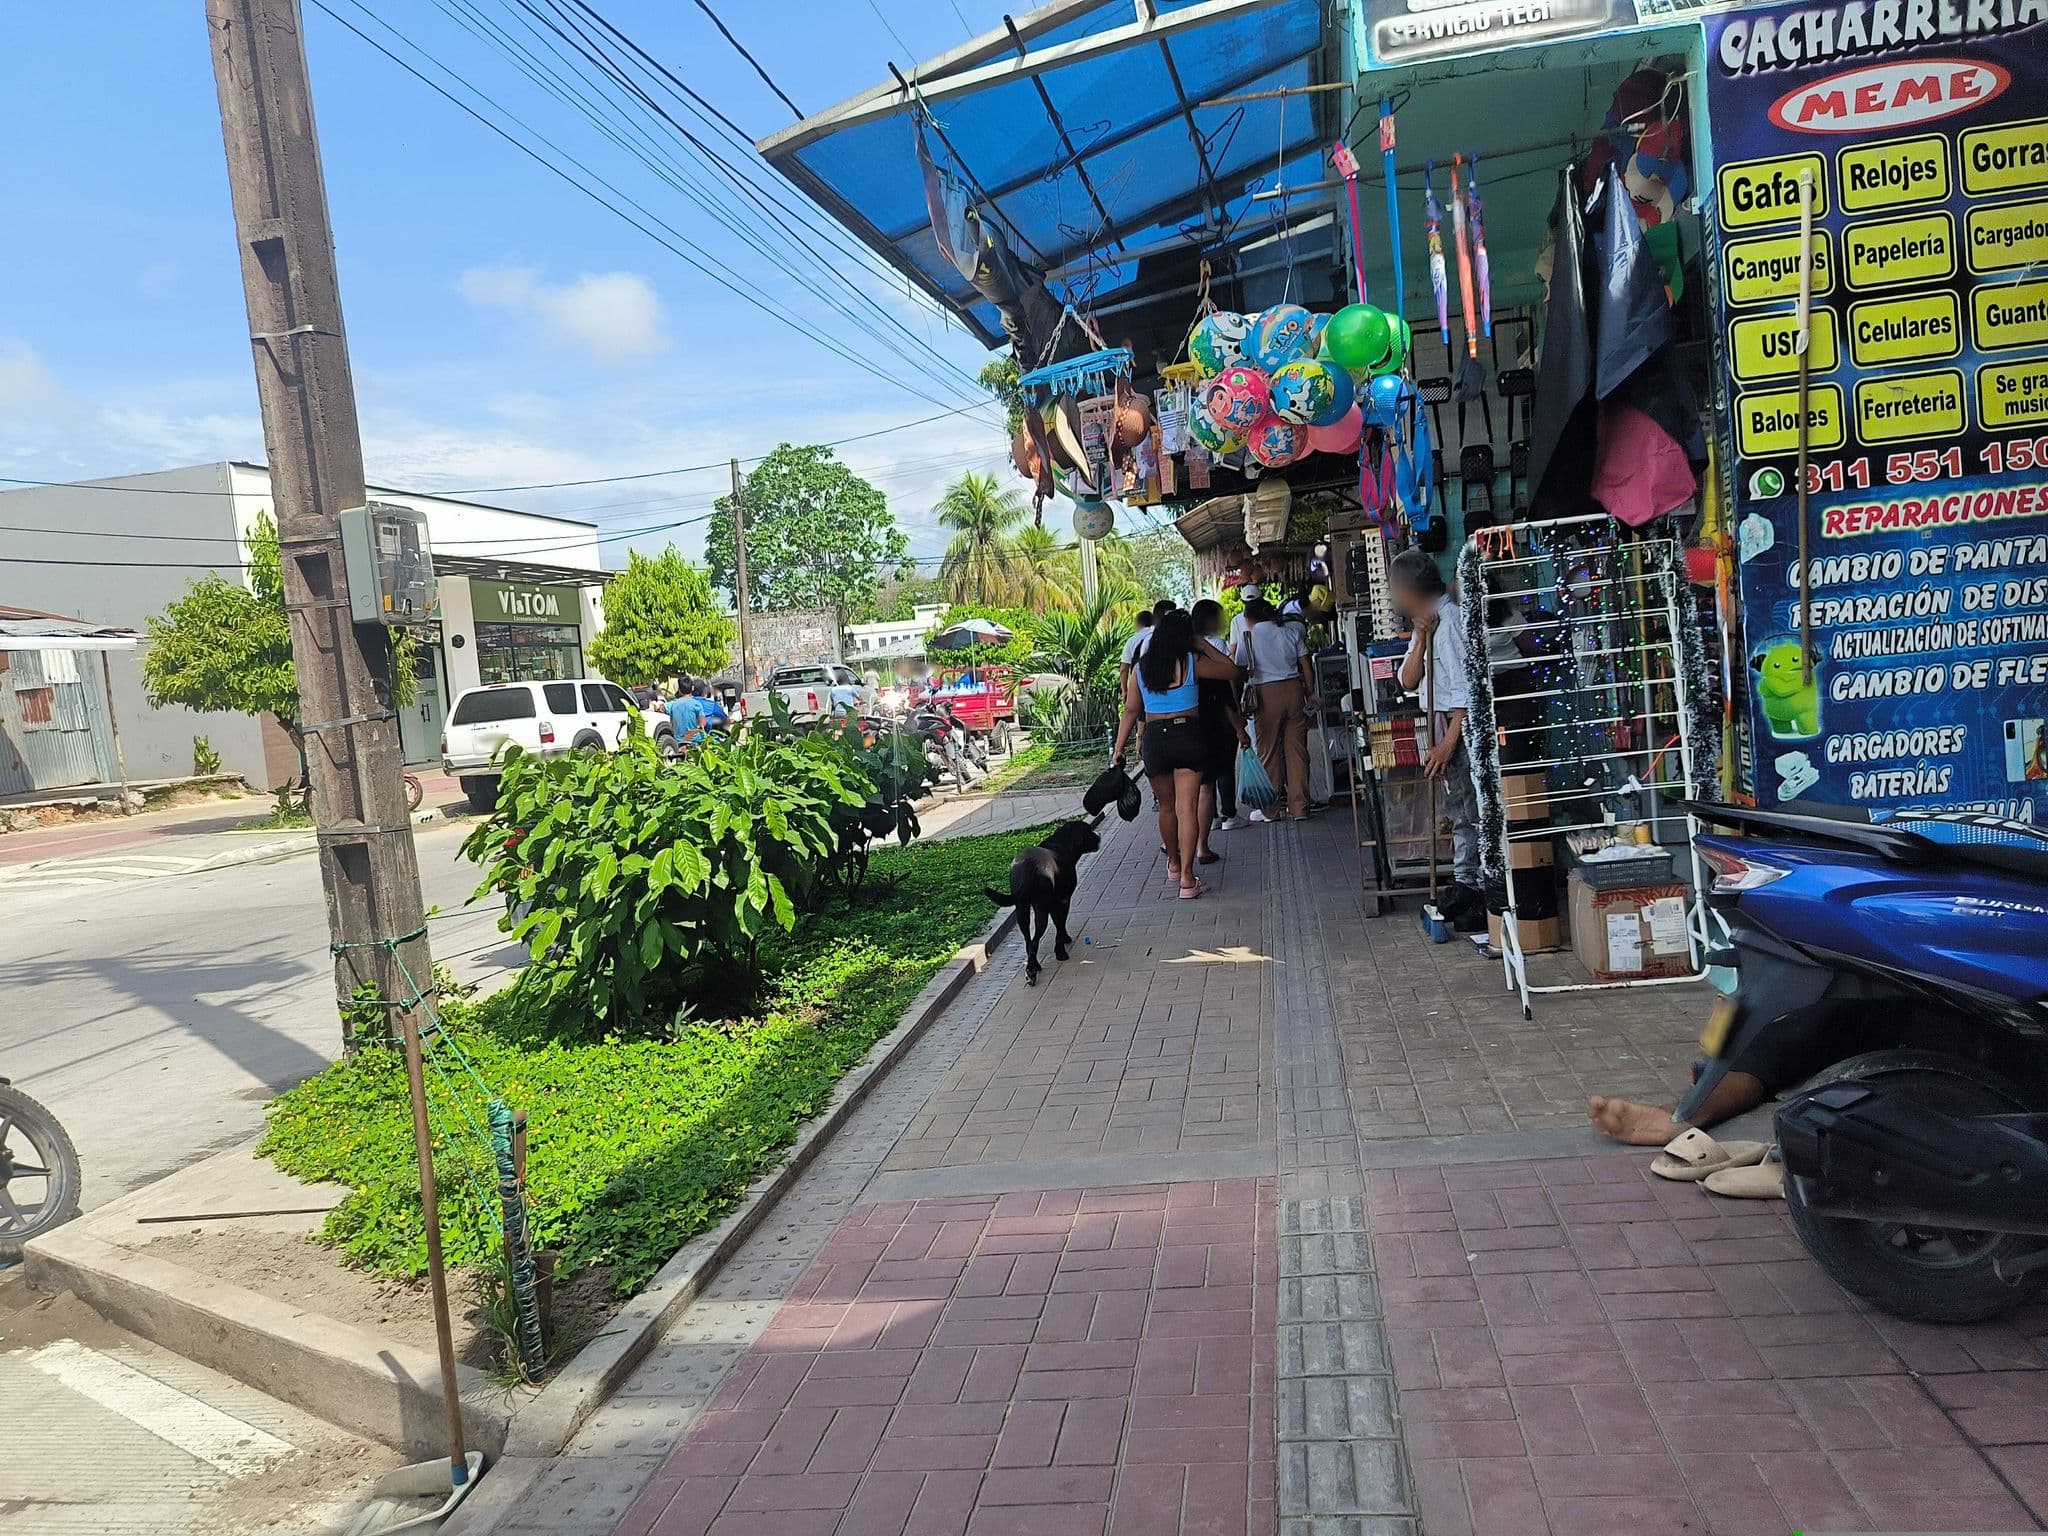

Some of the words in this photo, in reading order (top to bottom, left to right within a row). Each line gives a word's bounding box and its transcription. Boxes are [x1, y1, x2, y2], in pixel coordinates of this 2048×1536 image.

[1388, 11, 1491, 46] SERVICIO
[1796, 68, 1983, 123] MEME
[1850, 156, 1937, 192] Relojes
[1972, 142, 2048, 173] Gorra
[1853, 232, 1945, 269] Papelería
[1858, 314, 1952, 345] Celulares
[1986, 298, 2048, 327] Guant
[1996, 374, 2017, 393] Se
[1863, 391, 1957, 421] Ferreteria
[1795, 458, 1870, 494] 311
[1886, 447, 1962, 483] 551
[1823, 486, 2048, 535] REPARACIONES
[1789, 553, 1900, 588] CAMBIO
[1909, 548, 1949, 575] DE
[1955, 537, 2048, 571] PANTA
[1963, 583, 1998, 611] DE
[2003, 578, 2048, 607] DIS
[1832, 617, 1953, 659] ACTUALIZACIÓN
[1955, 619, 1977, 647] DE
[1831, 667, 1945, 700] CAMBIO
[1952, 661, 1990, 691] DE
[1998, 656, 2048, 686] FLE
[1826, 726, 1964, 762] CARGADORES
[1851, 762, 1952, 799] BATERÍAS
